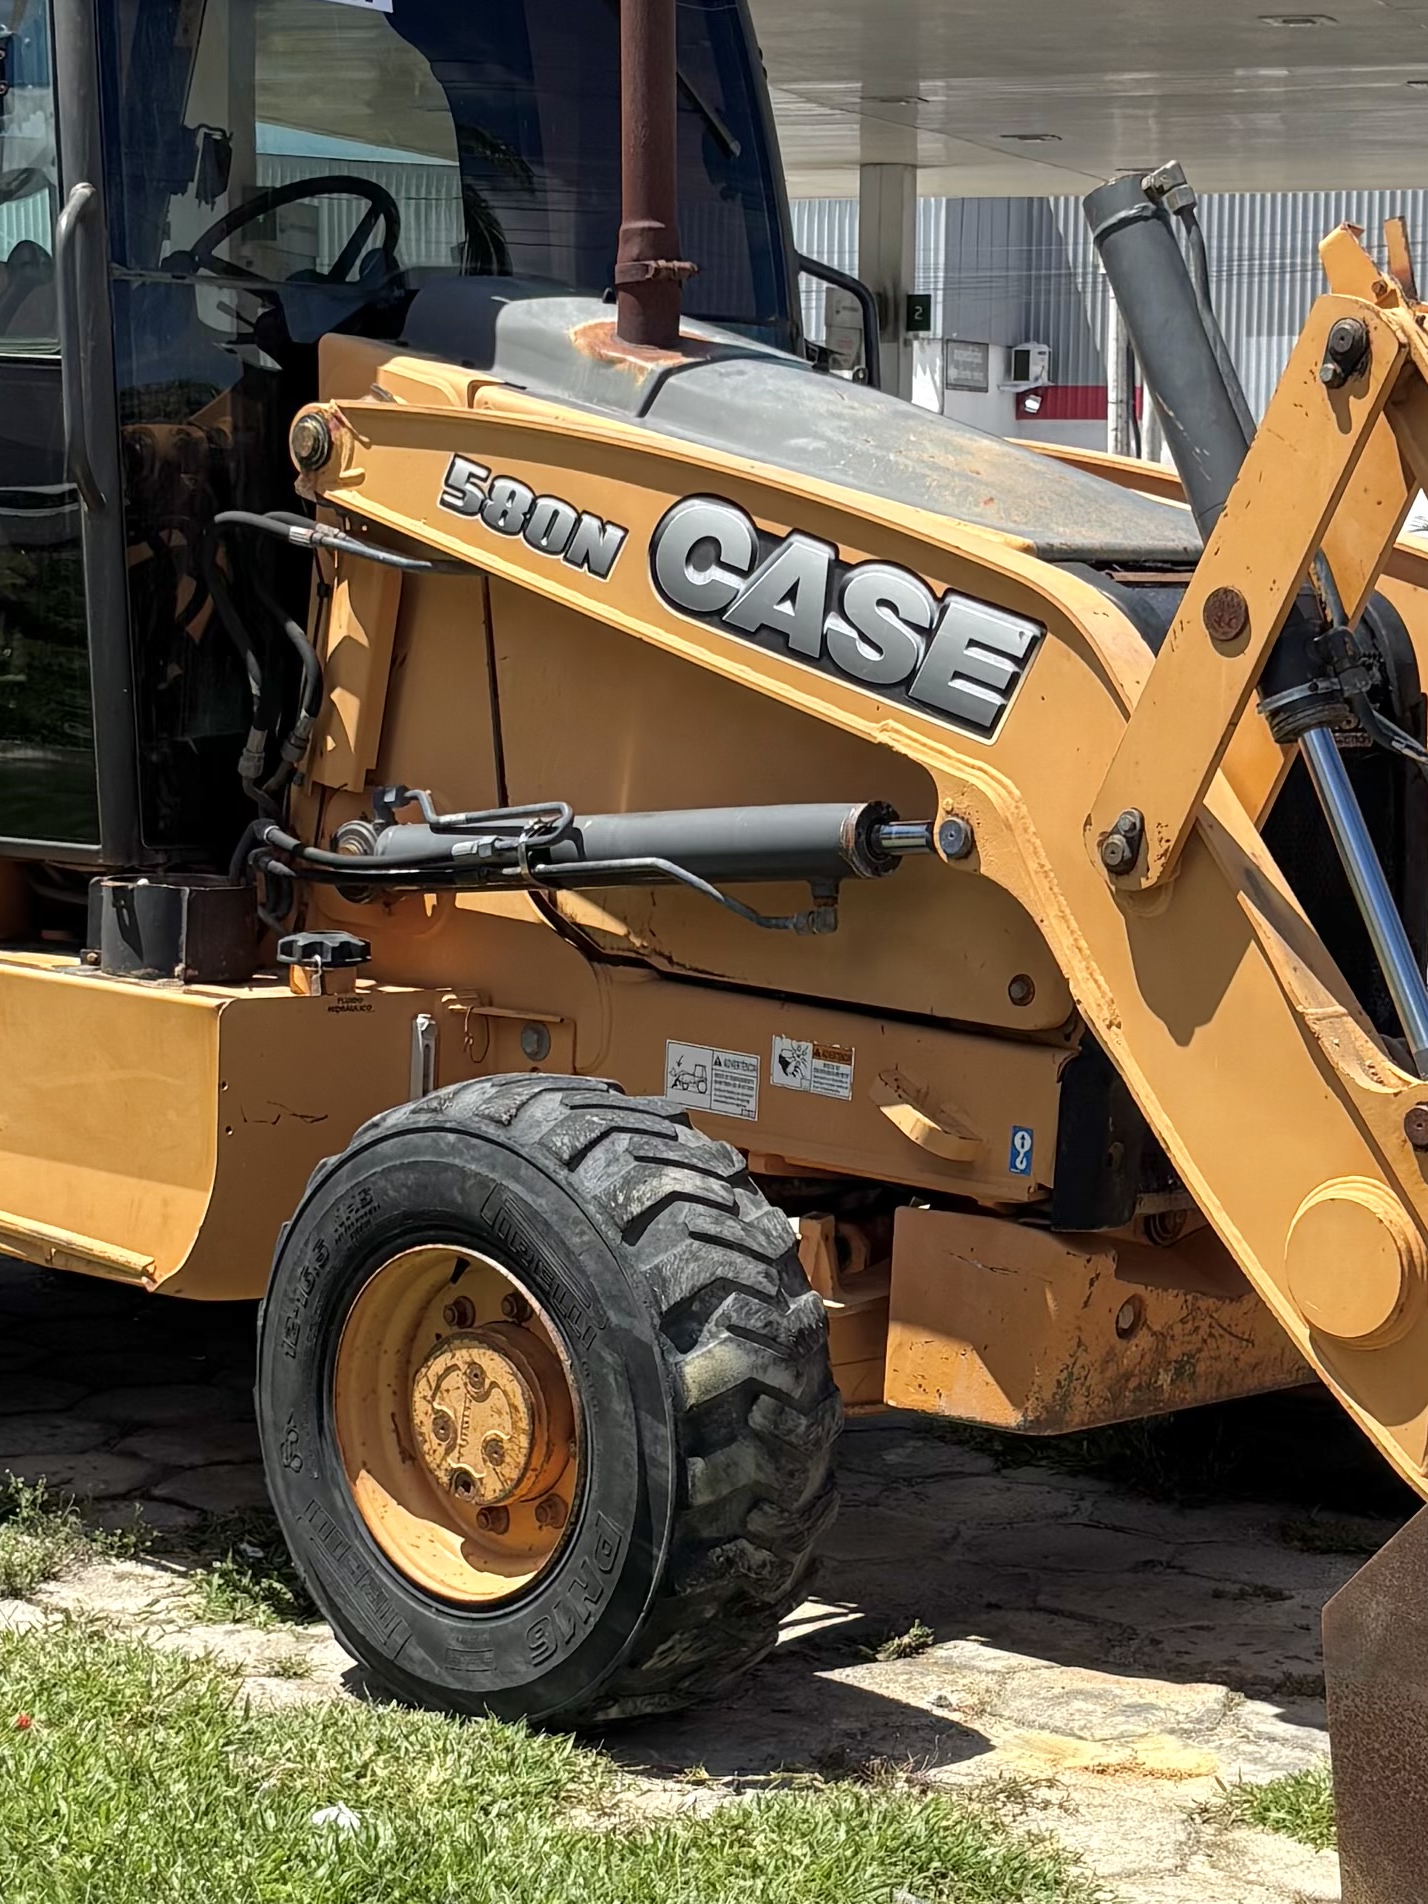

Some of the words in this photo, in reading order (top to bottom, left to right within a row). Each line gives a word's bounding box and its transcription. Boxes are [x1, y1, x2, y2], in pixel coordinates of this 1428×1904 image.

[914, 305, 923, 320] 2
[436, 453, 629, 582] 580N
[647, 493, 1047, 744] CASE
